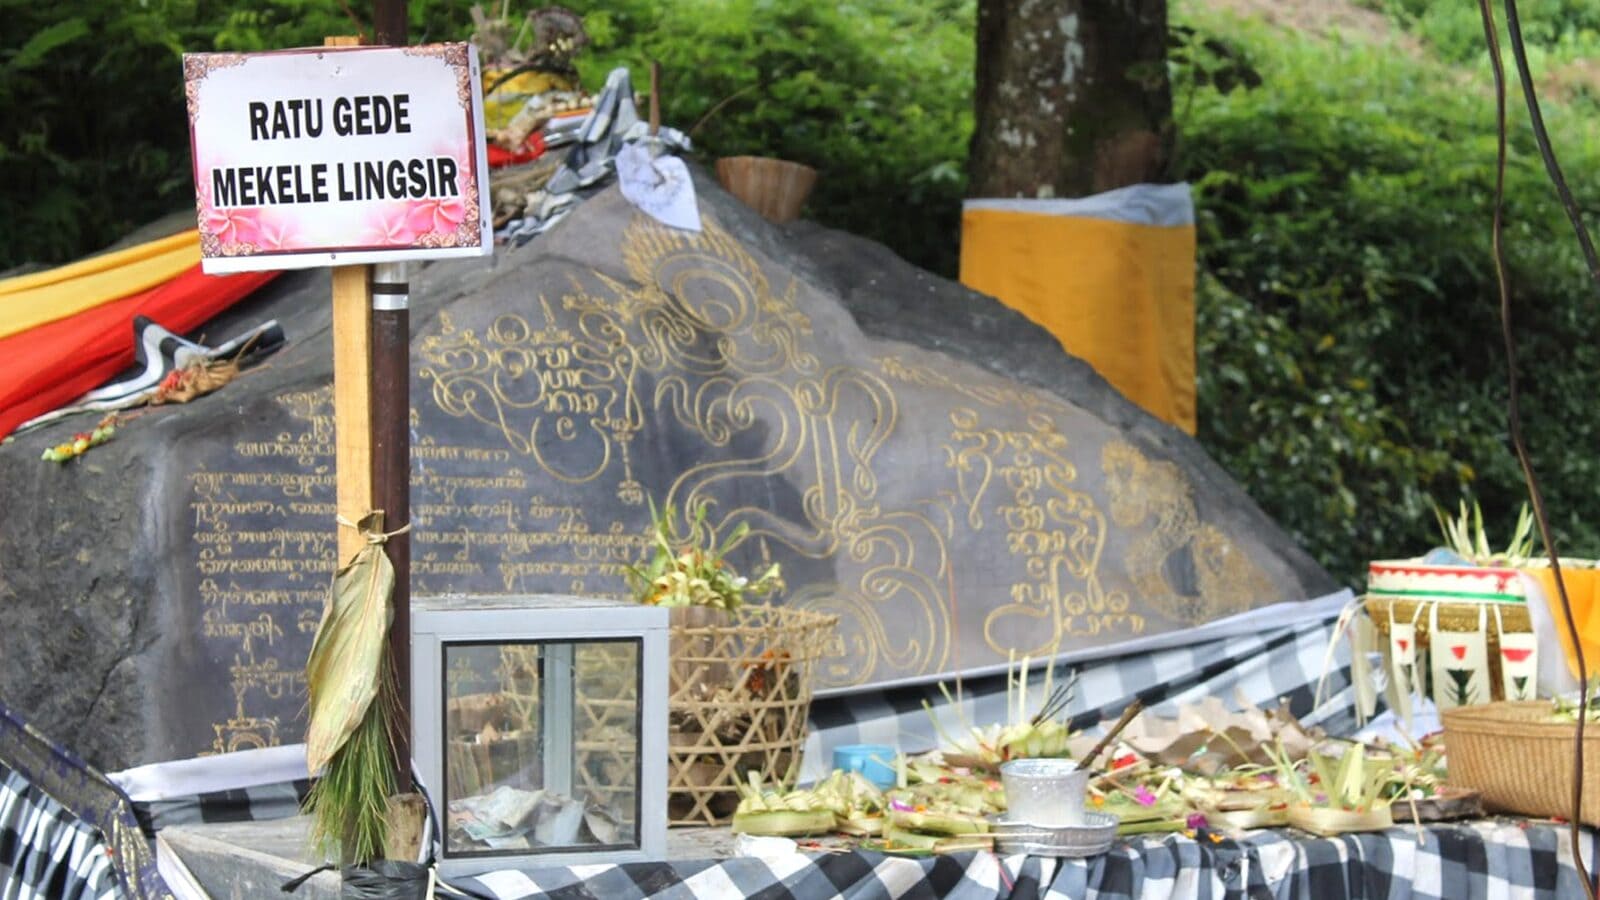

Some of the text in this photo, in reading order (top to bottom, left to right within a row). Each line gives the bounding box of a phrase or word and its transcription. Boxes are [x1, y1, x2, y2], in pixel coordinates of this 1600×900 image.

[249, 93, 411, 141] RATU GEDE
[212, 157, 459, 207] MEKELE LINGSIR
